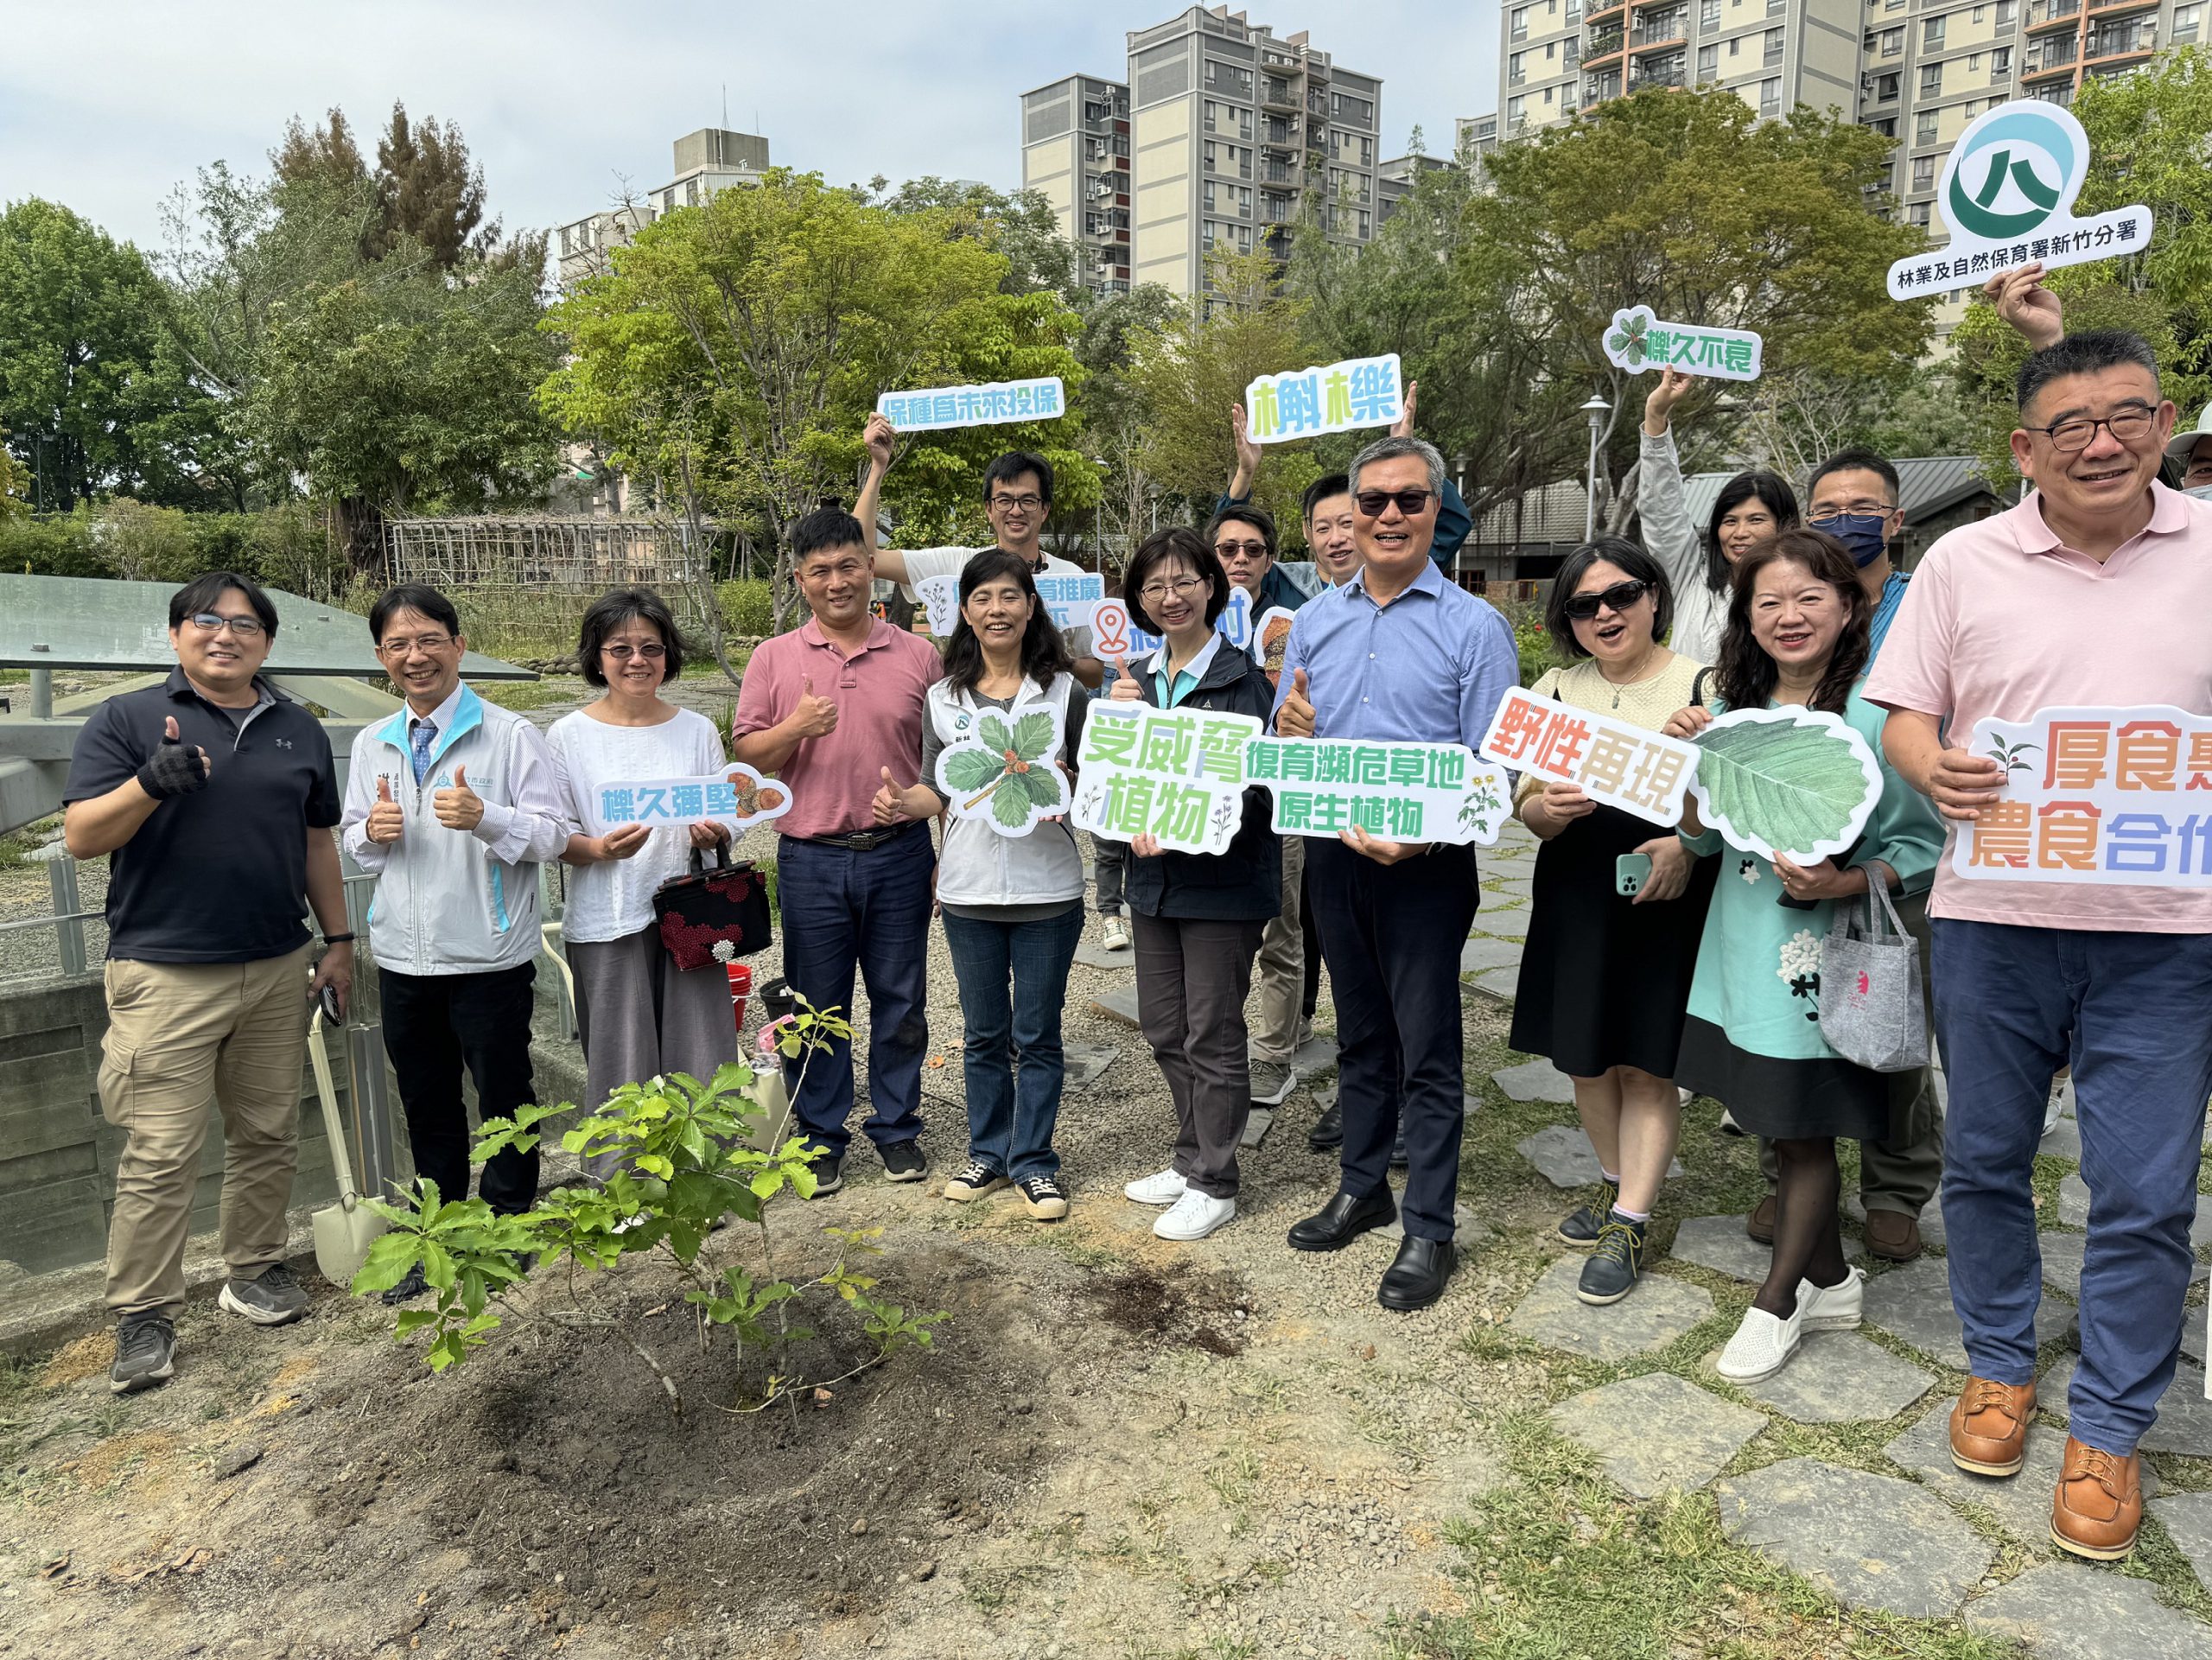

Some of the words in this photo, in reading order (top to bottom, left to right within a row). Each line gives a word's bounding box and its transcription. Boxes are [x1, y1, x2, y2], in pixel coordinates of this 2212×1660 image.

[1897, 219, 2137, 289] 林業及自然保育署新竹分署
[1646, 328, 1753, 373] 櫟久不衰
[1084, 707, 1254, 784] 受威脅
[1245, 741, 1465, 790] 復育瀕危草地
[1489, 696, 1686, 815] 野性再現
[601, 782, 736, 822] 櫟久彌堅
[1096, 772, 1211, 845] 植物
[1277, 791, 1424, 838] 原生植物
